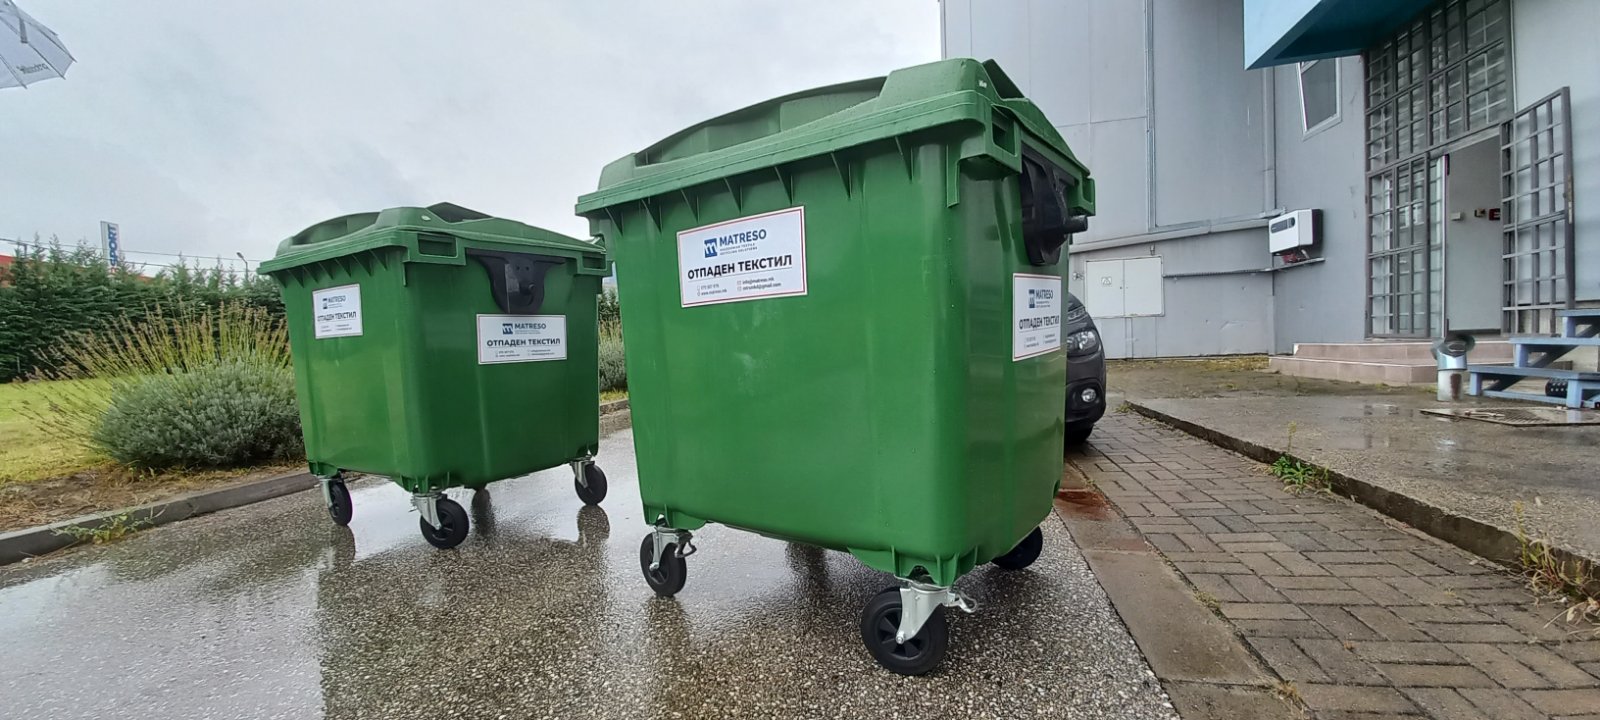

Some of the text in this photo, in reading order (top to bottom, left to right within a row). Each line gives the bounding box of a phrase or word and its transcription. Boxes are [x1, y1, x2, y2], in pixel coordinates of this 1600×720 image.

[107, 223, 118, 266] SPORT
[719, 229, 767, 247] MATRESO
[687, 254, 792, 280] ОТПАДЕН ТЕКСТИЛ
[514, 322, 547, 330] MATRESO
[486, 339, 527, 347] ОТПАДЕН
